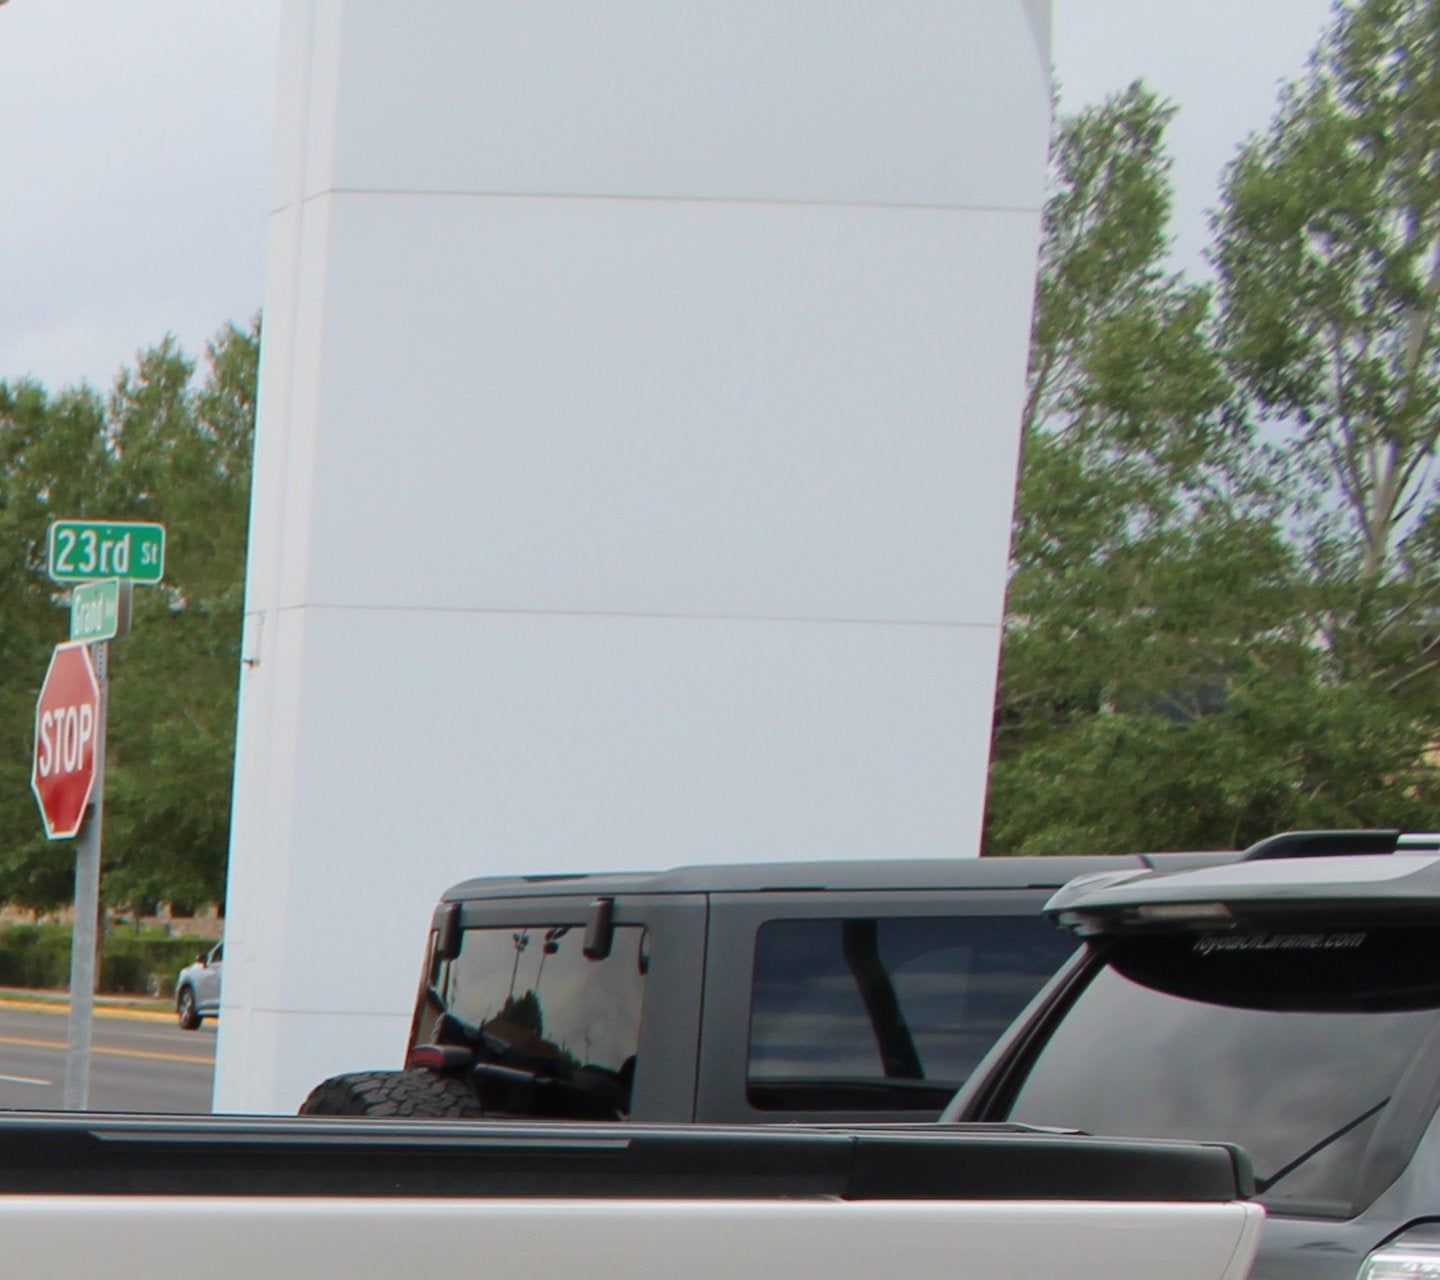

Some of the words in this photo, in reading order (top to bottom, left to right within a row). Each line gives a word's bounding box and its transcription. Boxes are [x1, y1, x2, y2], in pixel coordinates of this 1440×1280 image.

[56, 529, 130, 574] 23rd
[140, 541, 159, 565] St
[39, 704, 93, 778] STOP
